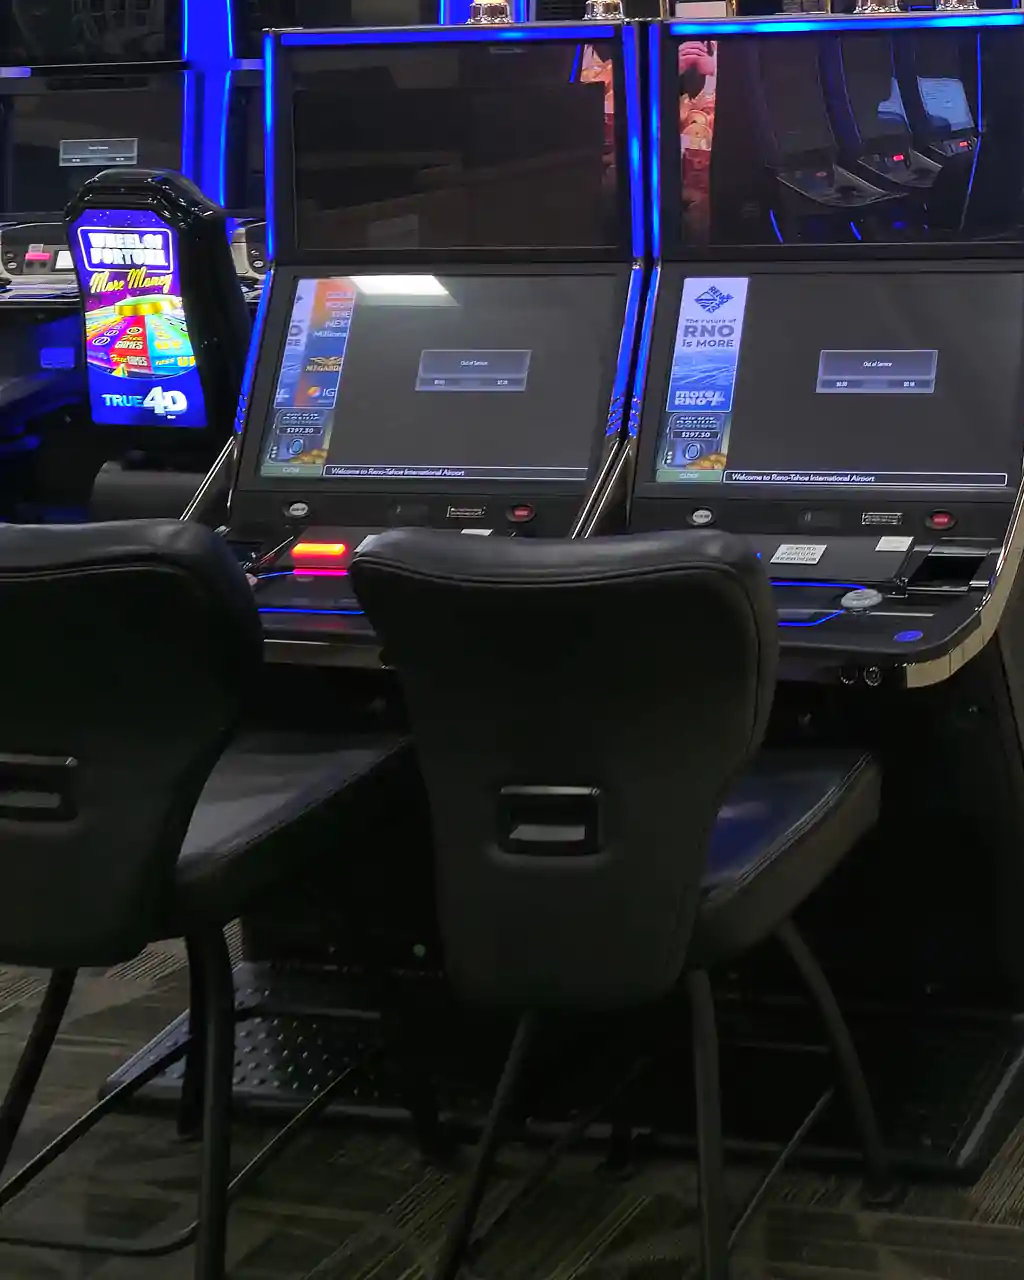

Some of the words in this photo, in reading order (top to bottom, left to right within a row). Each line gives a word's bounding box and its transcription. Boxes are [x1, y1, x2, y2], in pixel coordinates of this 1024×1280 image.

[90, 271, 124, 294] More
[127, 266, 172, 294] Money
[683, 325, 735, 338] RNO
[682, 339, 692, 348] is
[696, 339, 734, 347] MORE
[675, 390, 714, 400] more
[331, 467, 360, 475] Welcome
[404, 468, 442, 476] International
[442, 469, 465, 477] Airport
[732, 473, 762, 481] Welcome
[771, 473, 809, 482] Reno-Tahoe
[810, 473, 850, 482] International
[851, 474, 876, 482] Airport
